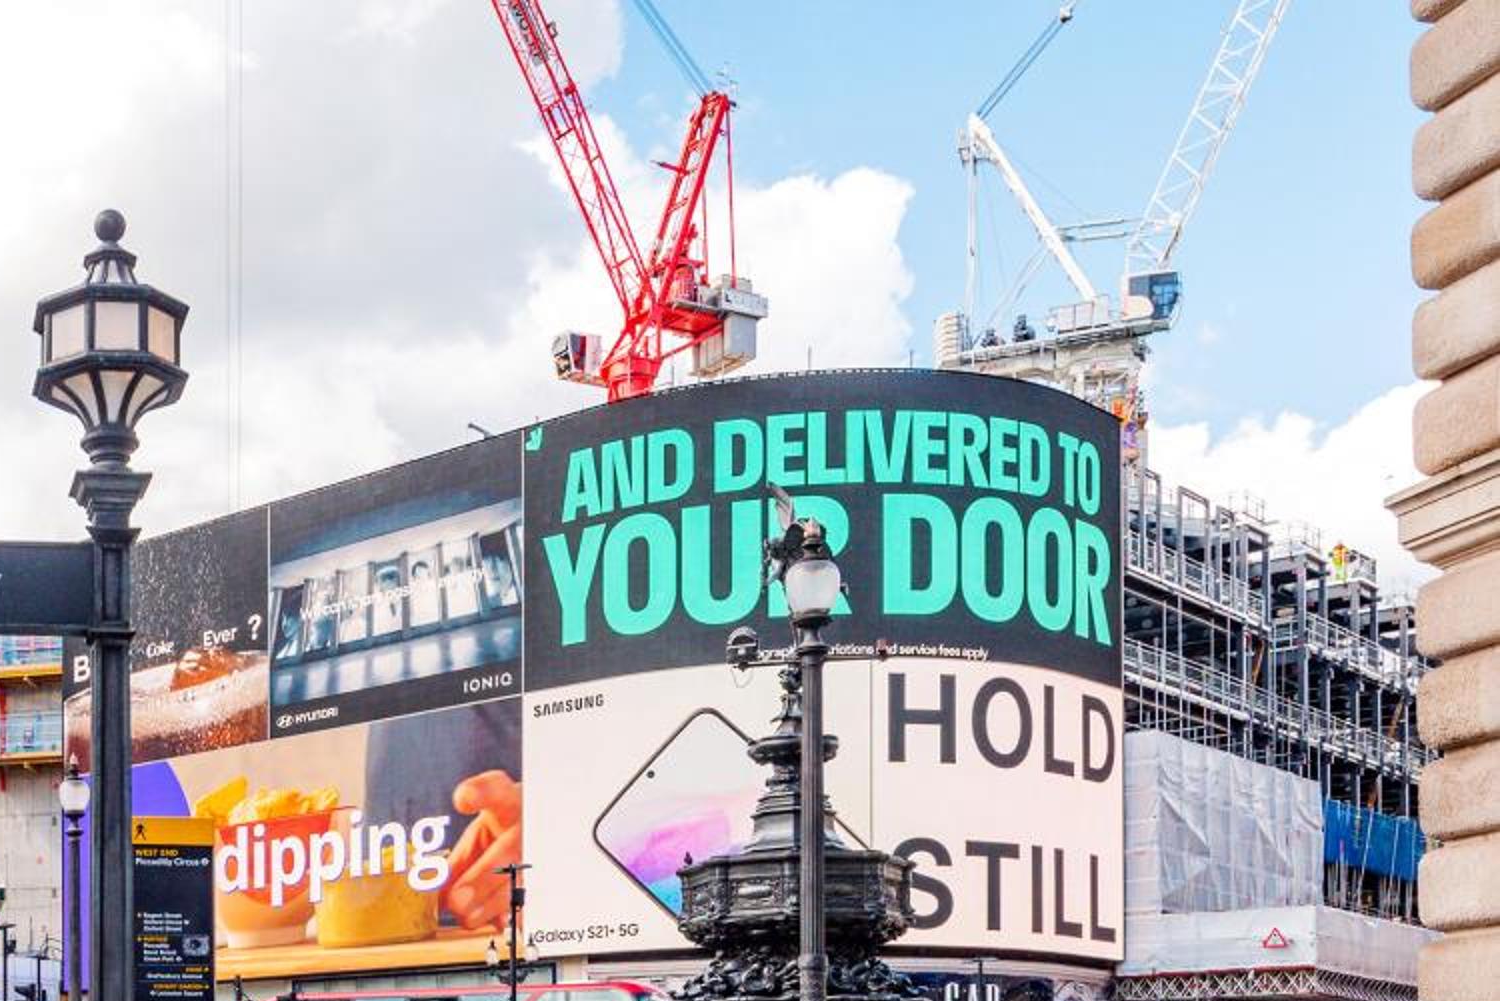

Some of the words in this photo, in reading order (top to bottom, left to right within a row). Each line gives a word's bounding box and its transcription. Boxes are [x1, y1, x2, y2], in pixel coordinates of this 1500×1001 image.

[561, 427, 695, 524] AND
[713, 409, 1051, 496] DELIVERED
[1058, 432, 1101, 519] TO
[542, 495, 852, 648] YOUR
[883, 492, 1112, 648] DOOR
[145, 640, 176, 659] Coke
[202, 626, 238, 648] Ever
[899, 643, 937, 656] service
[939, 643, 961, 657] fees
[961, 645, 988, 661] apply
[462, 671, 513, 694] IONIQ
[294, 706, 339, 725] HYUNDAI
[533, 693, 605, 718] SAMSUNG
[887, 672, 1117, 784] HOLD
[215, 808, 452, 907] dipping
[896, 837, 1118, 944] STILL
[533, 928, 585, 944] Galaxy
[618, 923, 639, 938] 5G
